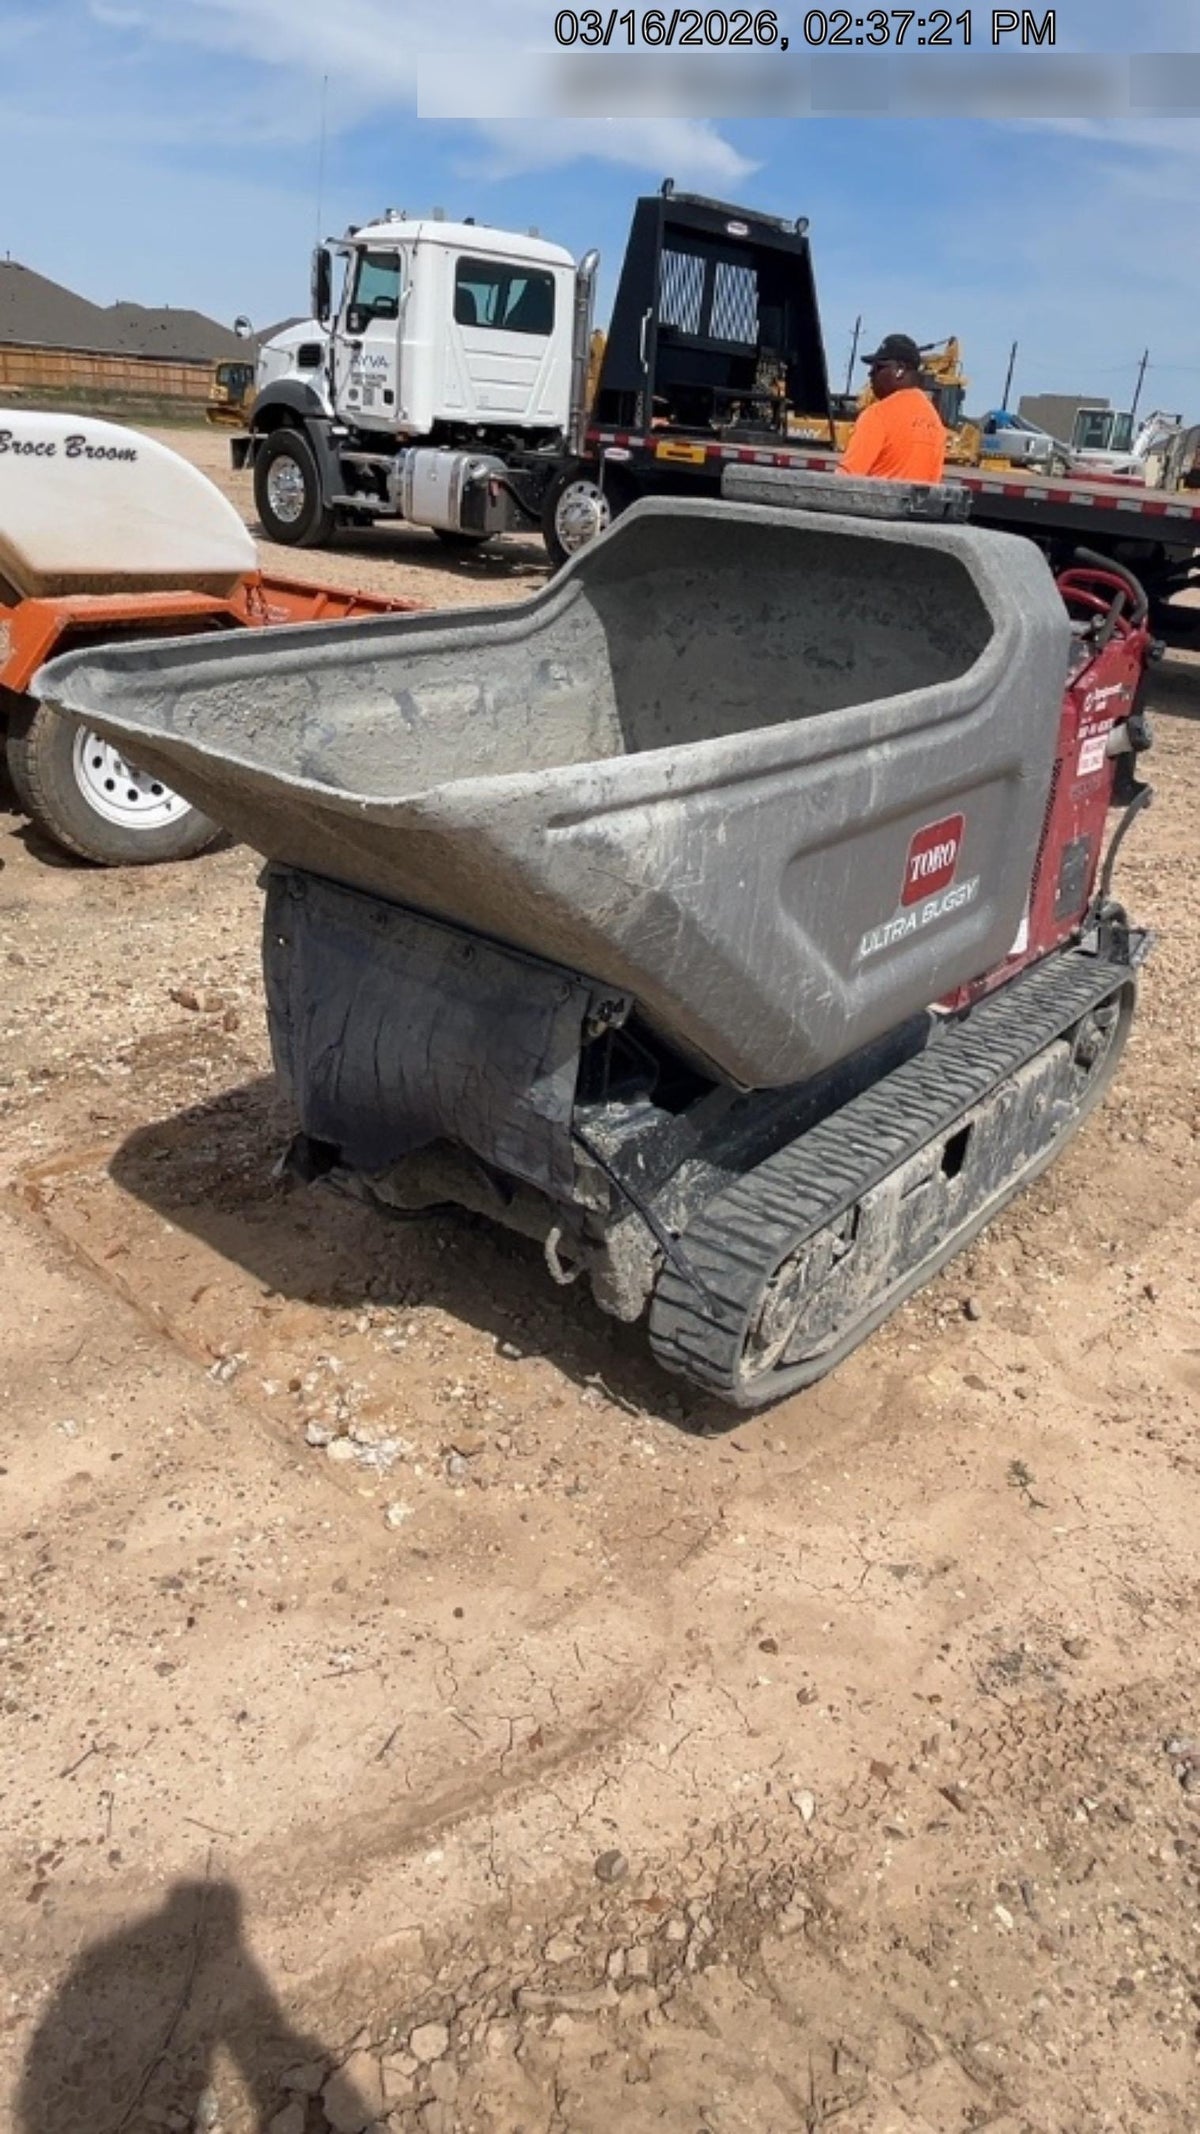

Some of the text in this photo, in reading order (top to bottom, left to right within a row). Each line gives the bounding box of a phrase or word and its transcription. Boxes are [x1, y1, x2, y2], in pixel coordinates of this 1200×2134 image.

[64, 434, 138, 461] Broom
[910, 839, 957, 882] TORO
[859, 875, 980, 958] ULTRA BUGGY
